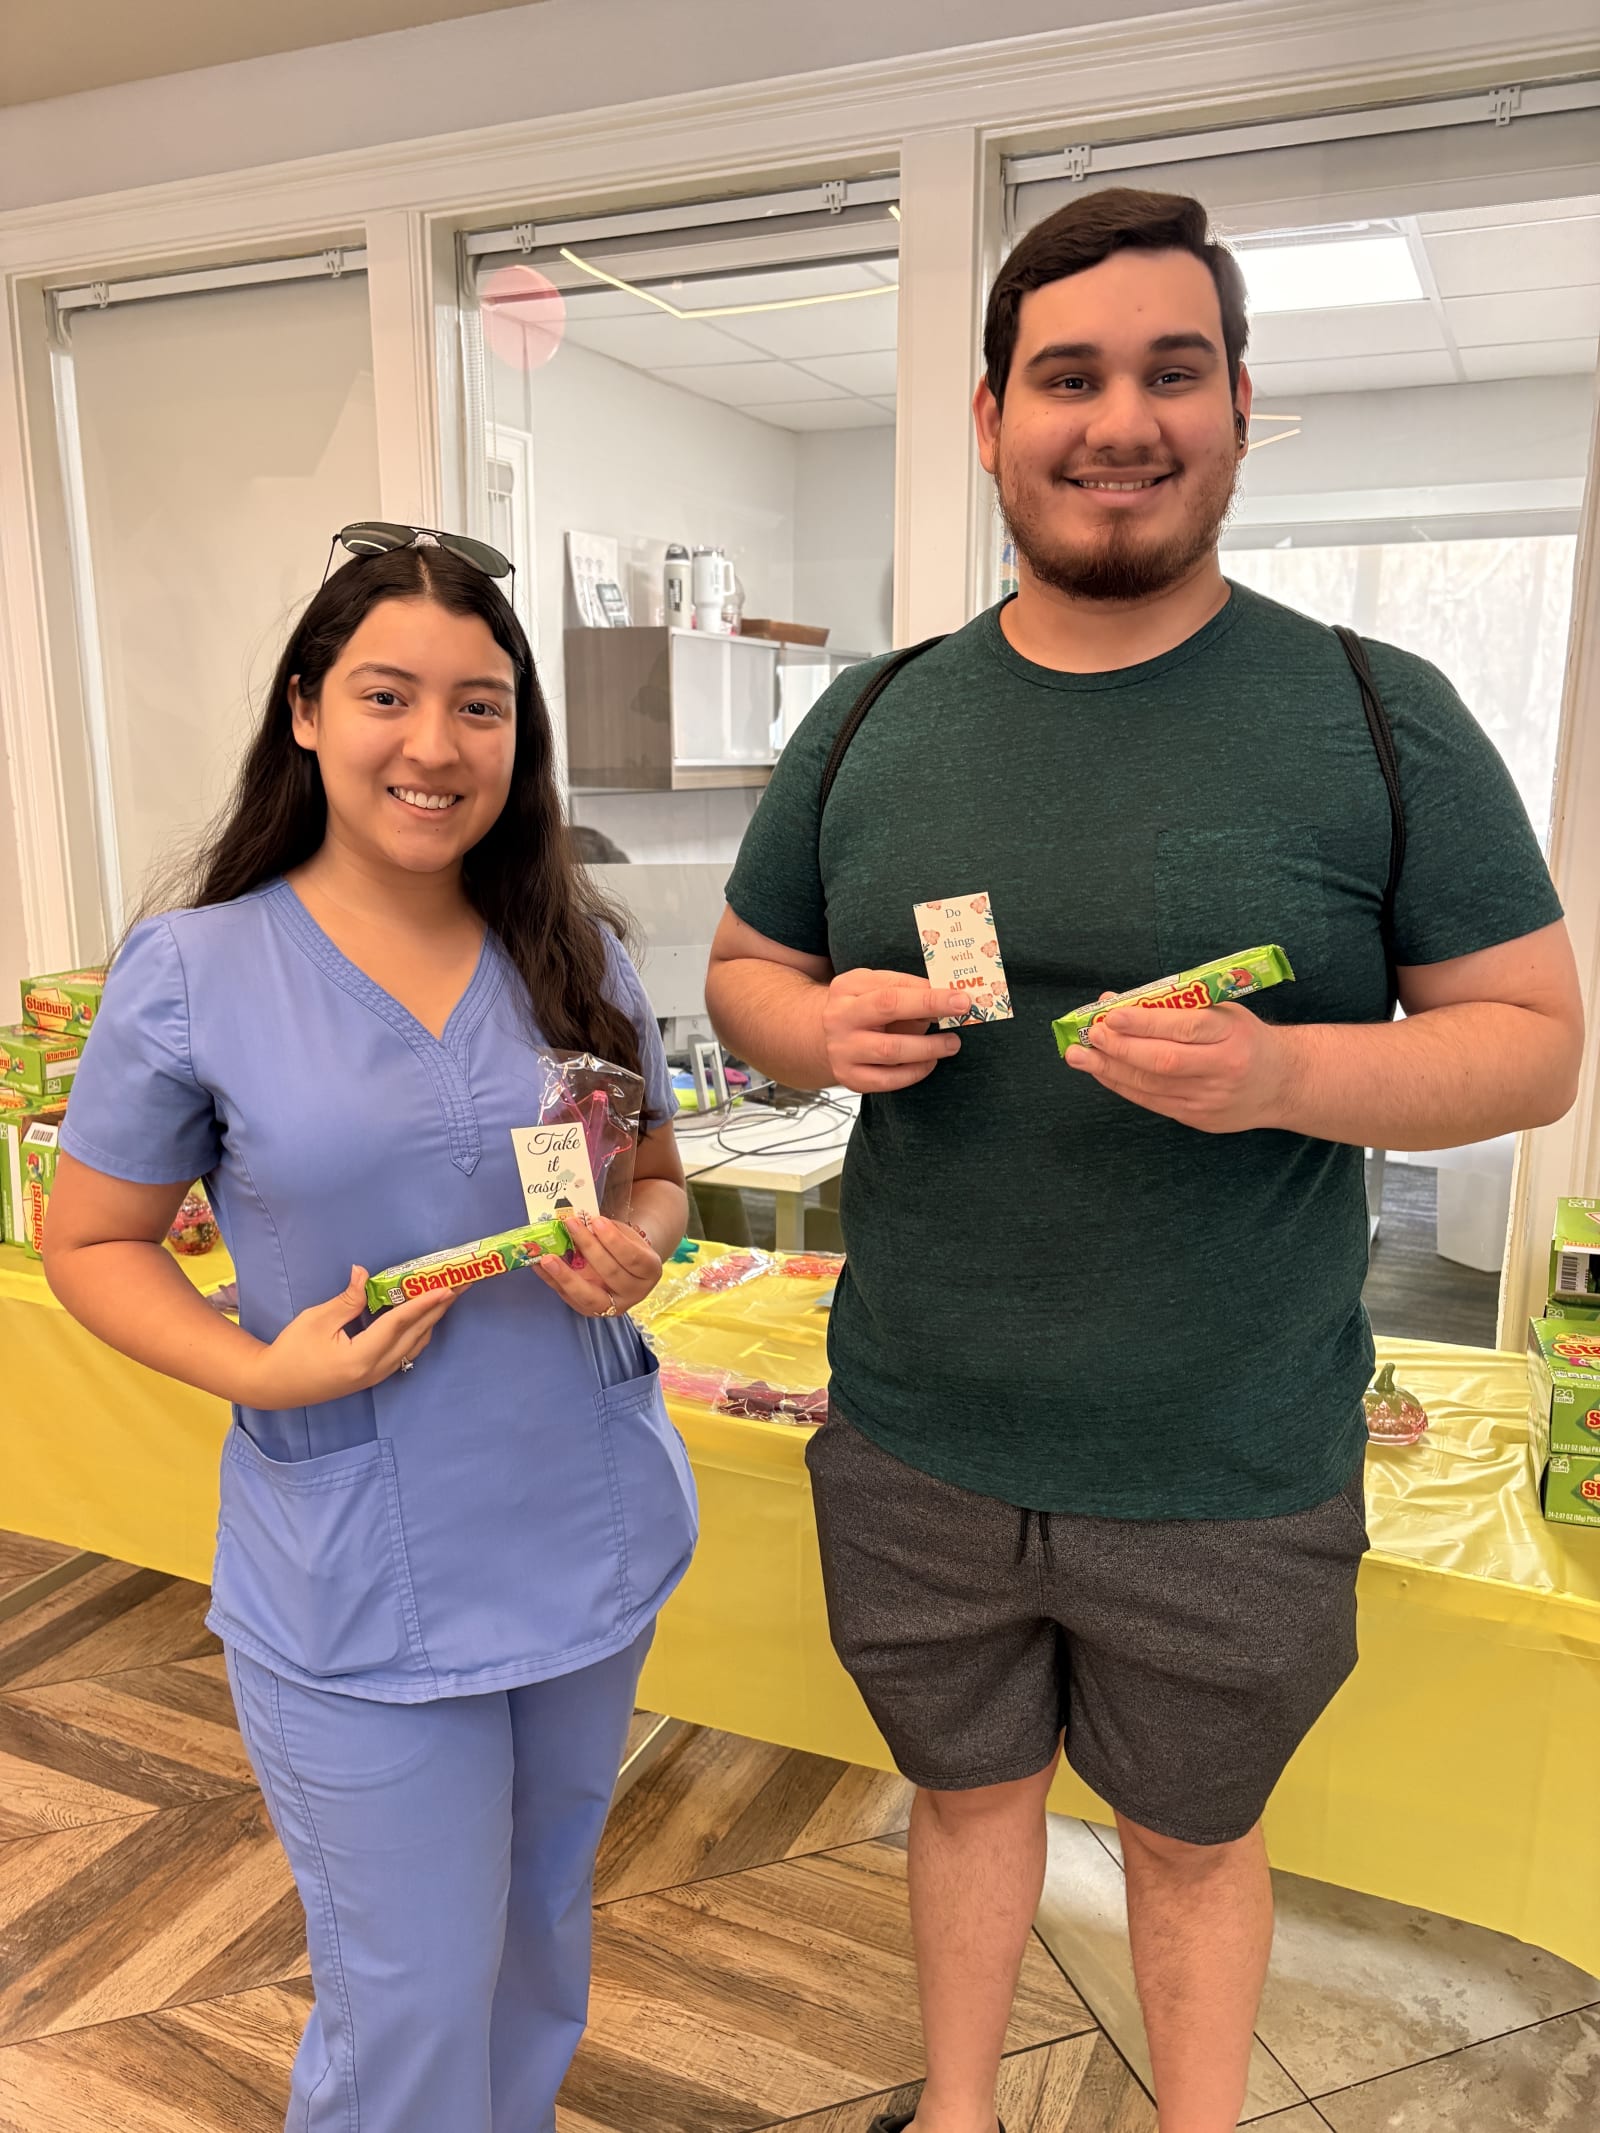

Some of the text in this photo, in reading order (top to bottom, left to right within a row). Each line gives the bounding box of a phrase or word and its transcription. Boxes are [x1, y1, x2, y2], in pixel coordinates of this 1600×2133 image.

[945, 908, 961, 918] Do
[950, 922, 962, 933] all
[944, 936, 976, 948] things
[951, 950, 974, 962] with
[953, 965, 978, 979] great
[25, 995, 73, 1019] Starburst
[46, 1047, 78, 1062] Starburst
[527, 1127, 581, 1156] Take
[547, 1156, 560, 1173] it
[31, 1184, 43, 1252] Starburst
[404, 1253, 505, 1297] Starburst
[1548, 1308, 1563, 1318] 24
[1555, 1389, 1573, 1399] 24
[1552, 1459, 1568, 1467] 24
